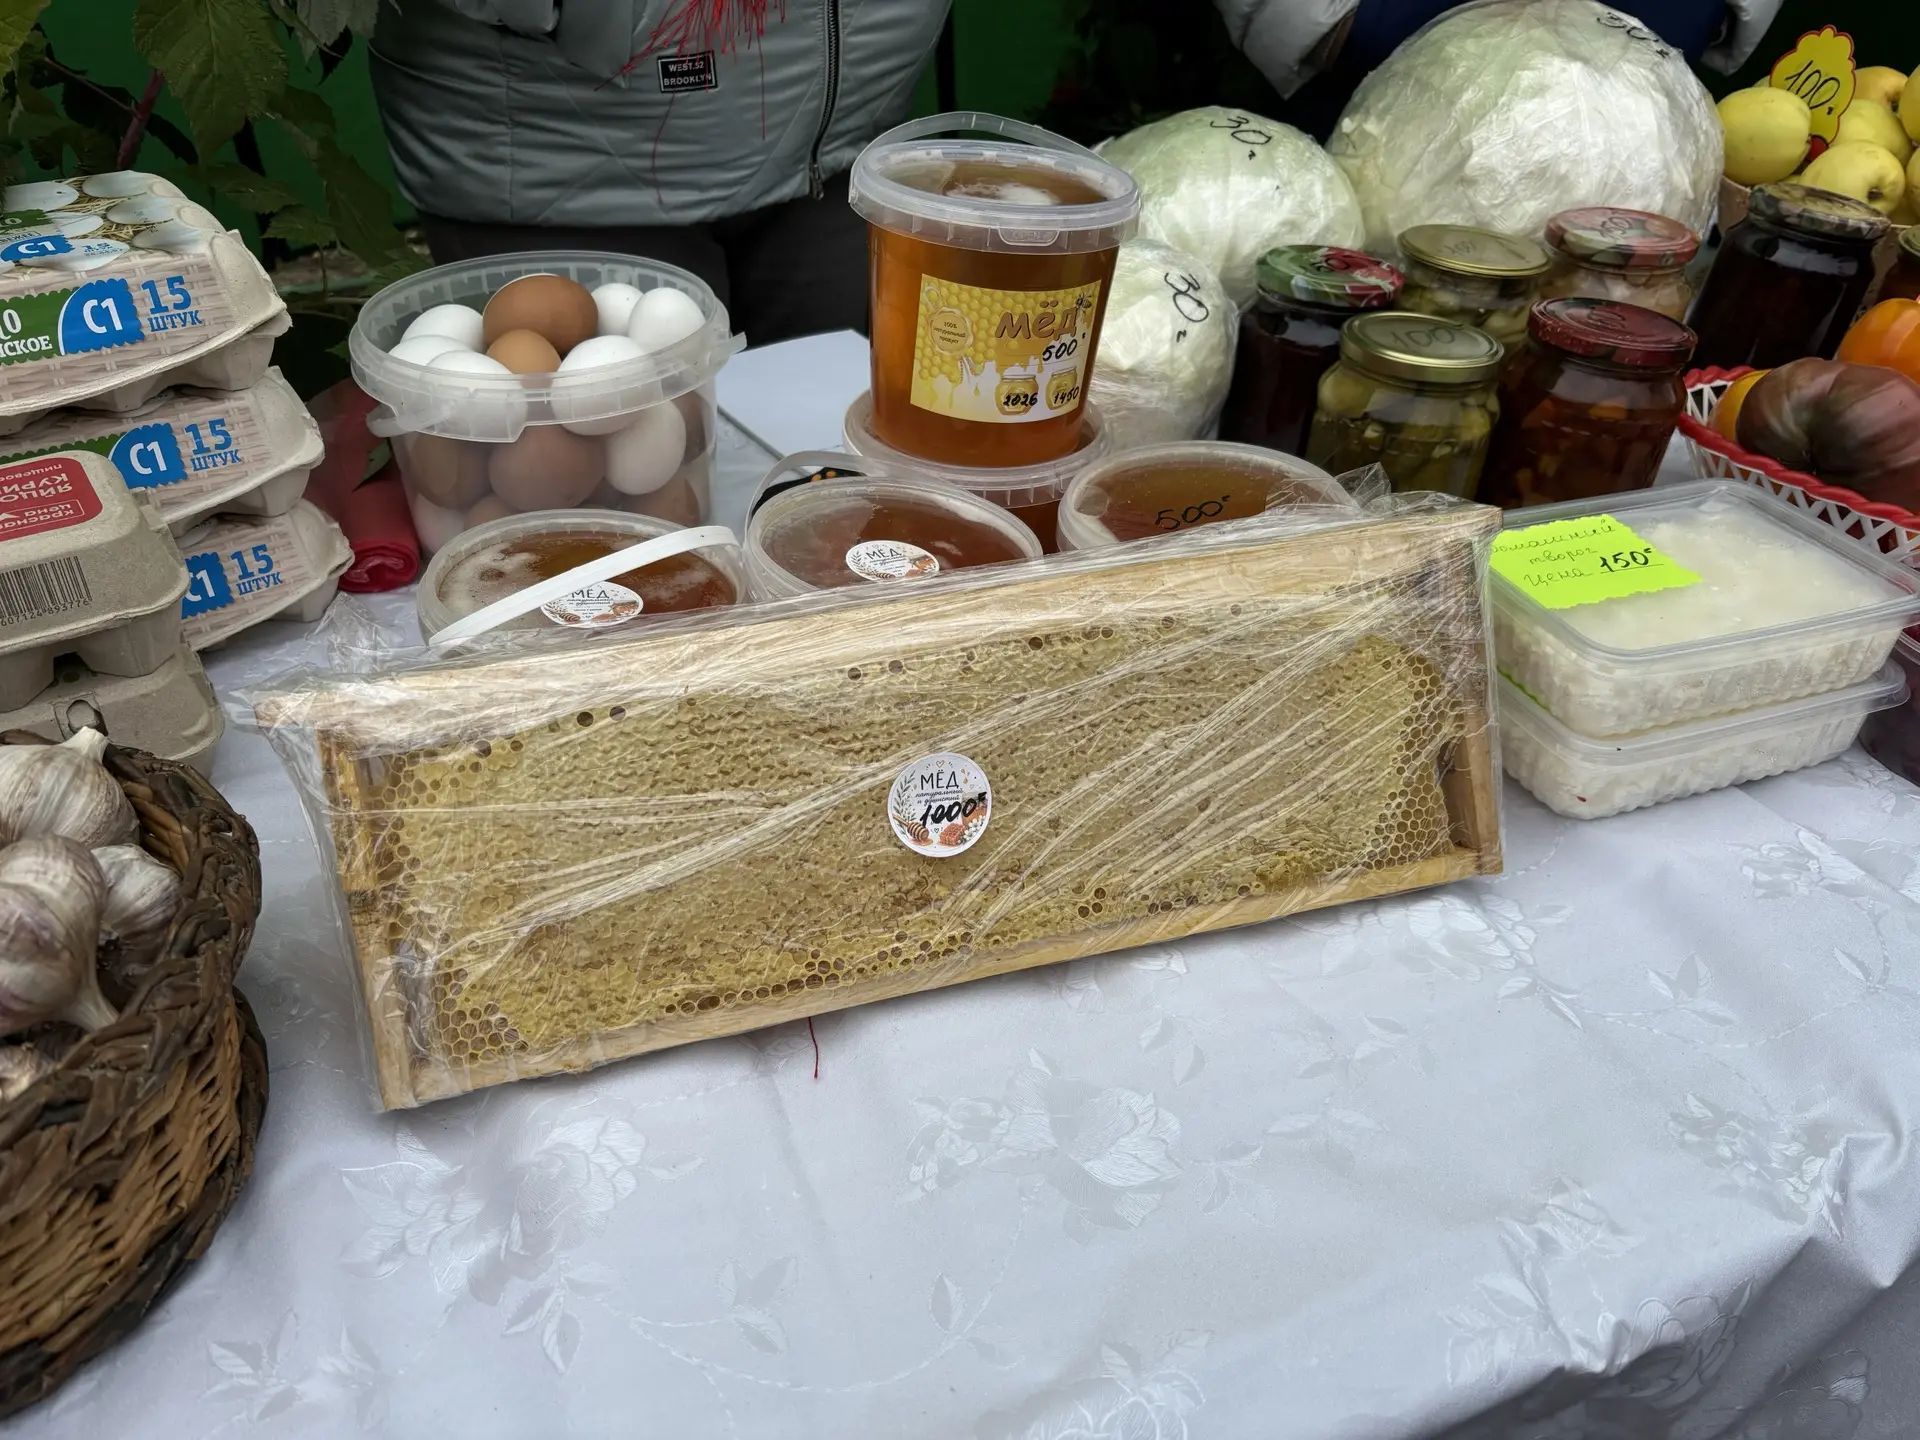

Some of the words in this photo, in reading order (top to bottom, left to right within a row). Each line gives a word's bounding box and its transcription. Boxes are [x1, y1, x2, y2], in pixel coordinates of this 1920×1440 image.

[663, 73, 712, 86] BROOKLYN
[141, 275, 193, 314] 15
[1164, 272, 1209, 322] 30
[147, 309, 204, 333] ШТУК
[184, 418, 234, 455] 15
[190, 449, 244, 472] ШТУК
[0, 473, 69, 495] КУРИ
[24, 503, 72, 517] цена
[230, 544, 275, 581] 15
[236, 571, 283, 596] ШТУК
[920, 769, 960, 790] МЁД
